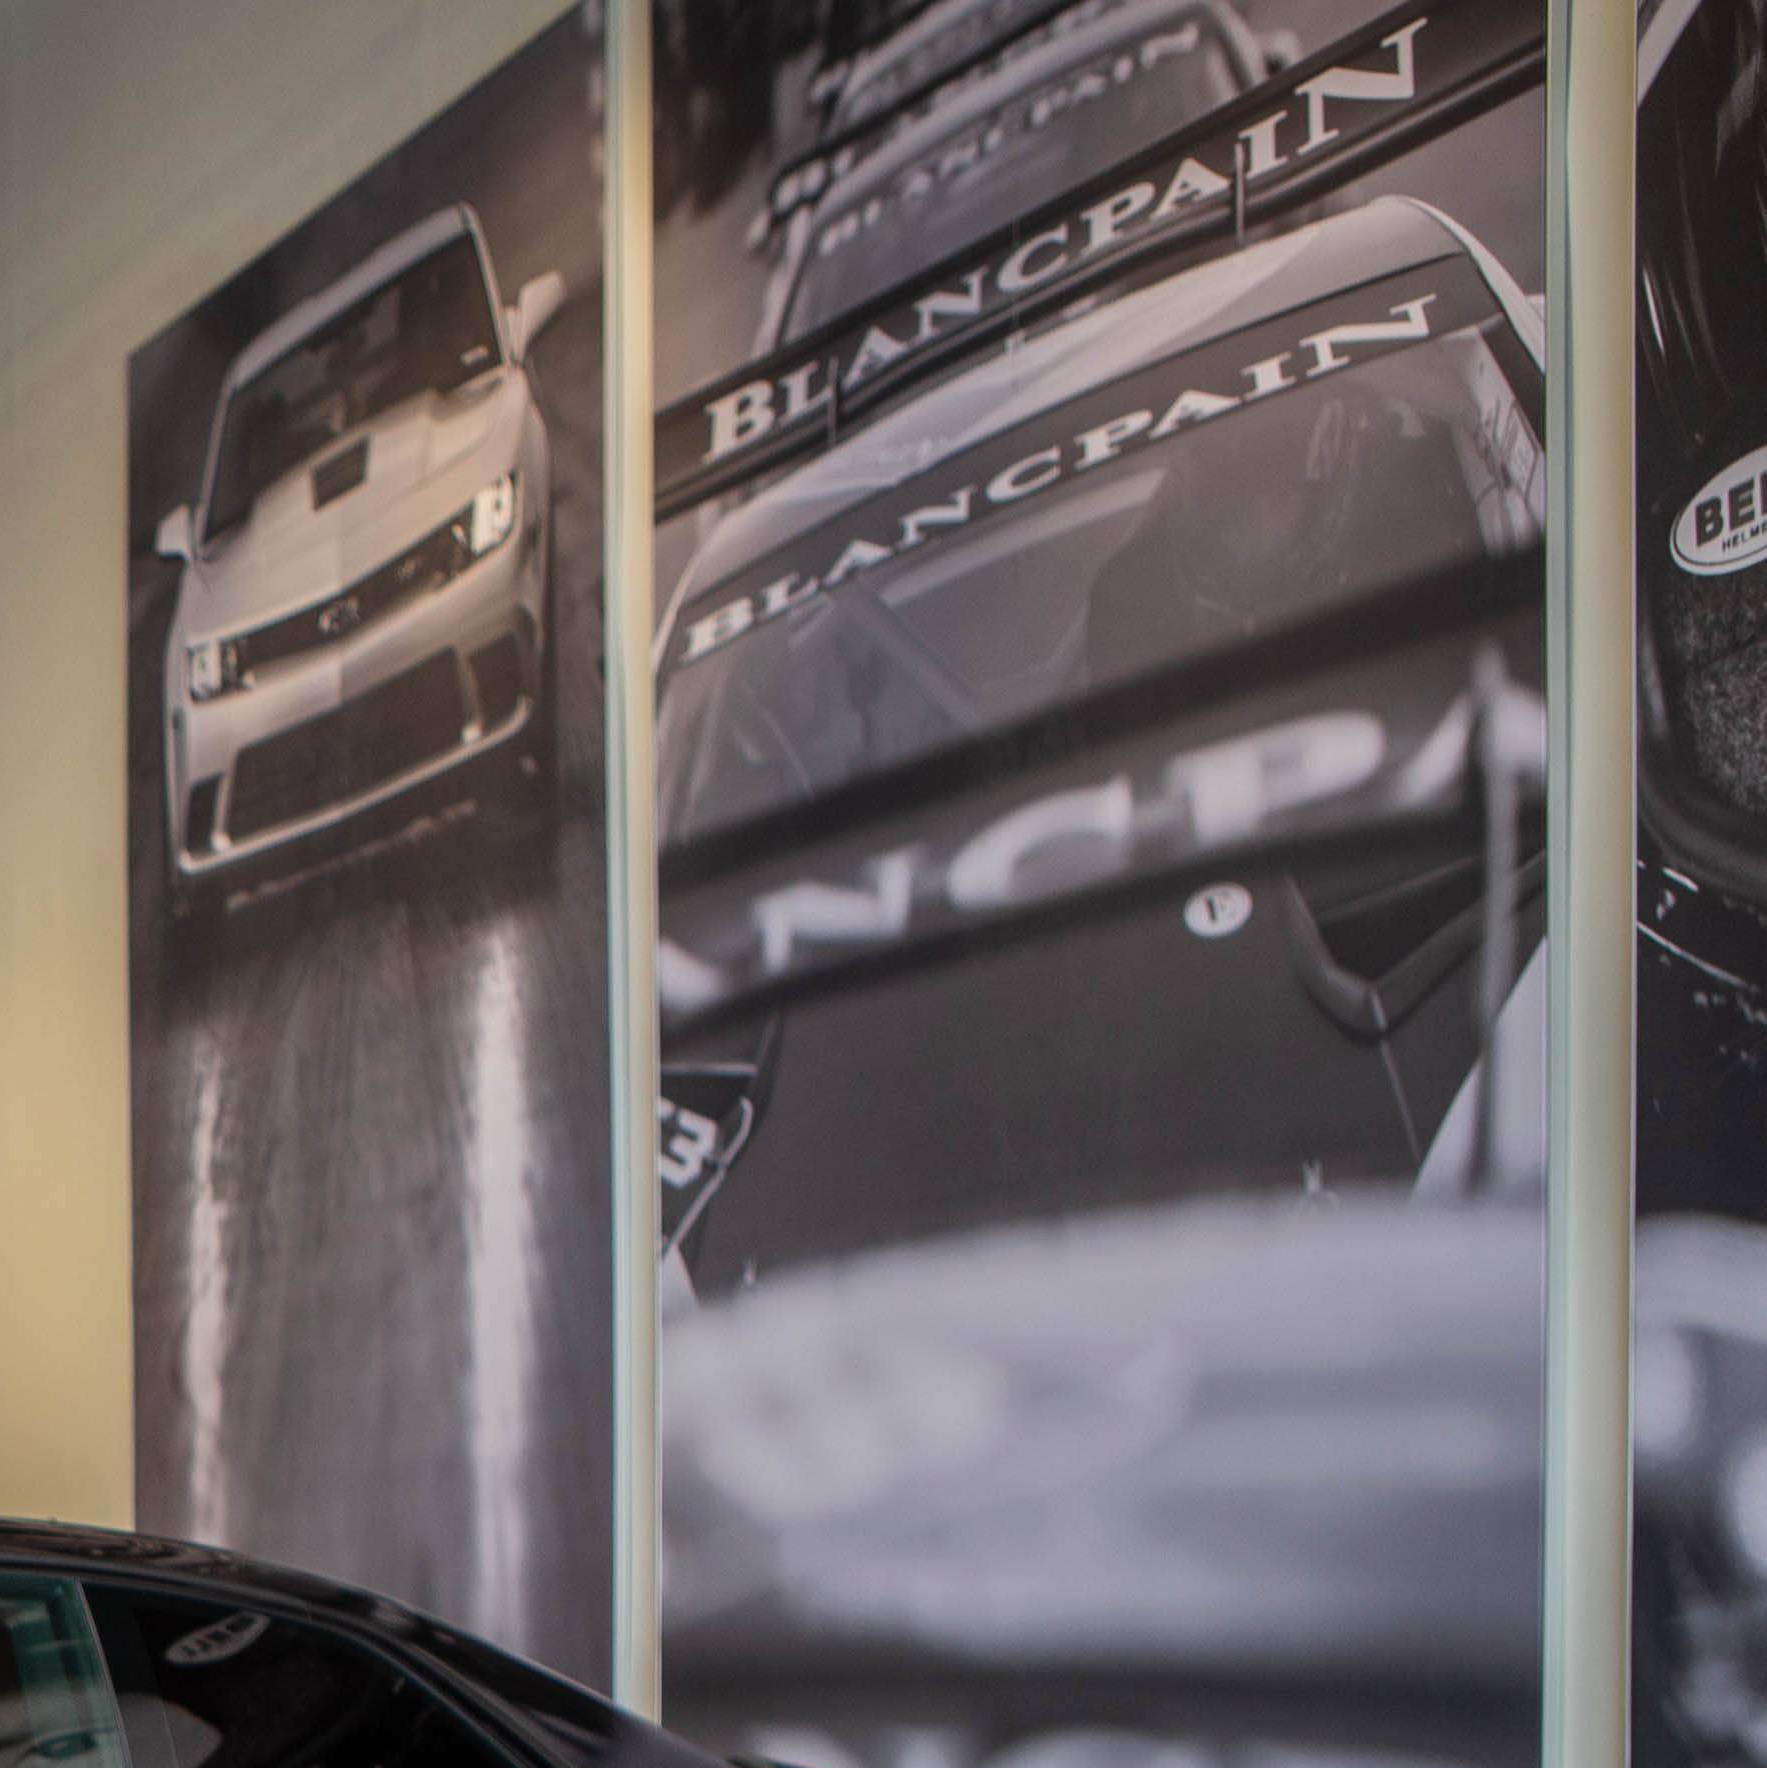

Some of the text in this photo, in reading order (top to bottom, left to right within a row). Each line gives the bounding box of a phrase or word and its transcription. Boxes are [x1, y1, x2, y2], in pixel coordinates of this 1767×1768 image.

[702, 17, 1428, 466] BLANCPAIN
[678, 293, 1438, 663] BLANCPAIN
[1695, 470, 1767, 547] BE
